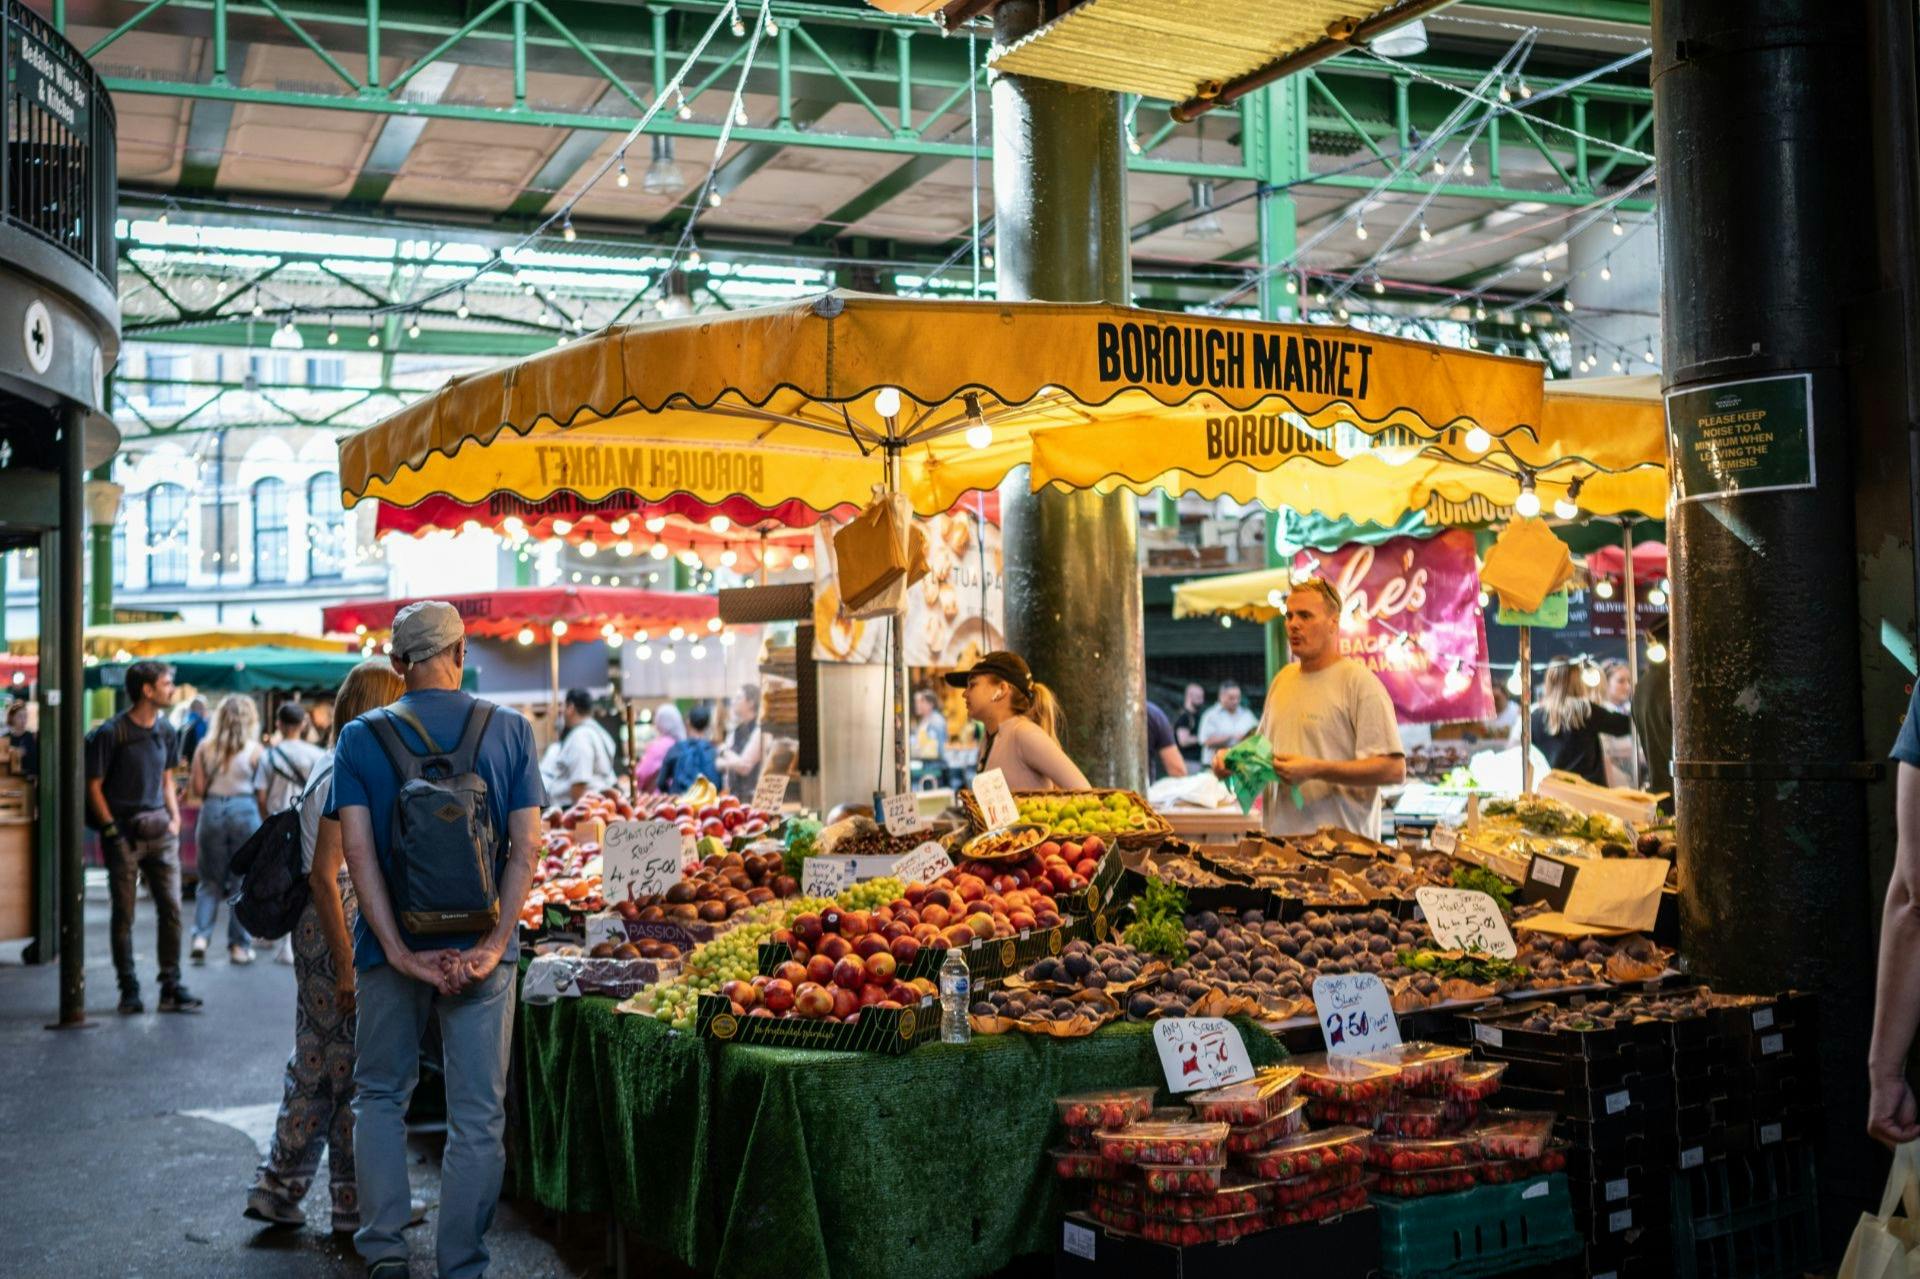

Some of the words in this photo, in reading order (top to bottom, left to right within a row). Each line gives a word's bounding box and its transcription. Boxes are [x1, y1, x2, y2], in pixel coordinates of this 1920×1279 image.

[22, 36, 54, 80] Bedales
[55, 62, 73, 97] Wine
[73, 80, 85, 108] Bar
[38, 78, 45, 102] &
[47, 84, 74, 125] Kitchen
[1097, 322, 1245, 389] BOROUGH
[1252, 333, 1373, 400] MARKET
[1698, 413, 1737, 428] PLEASE
[1737, 410, 1767, 422] KEEP
[1703, 425, 1734, 438] NOISE
[1735, 423, 1752, 434] TO
[1753, 422, 1762, 433] A
[1740, 432, 1774, 444] WHEN
[1746, 445, 1768, 455] THE
[629, 924, 687, 939] PASSION
